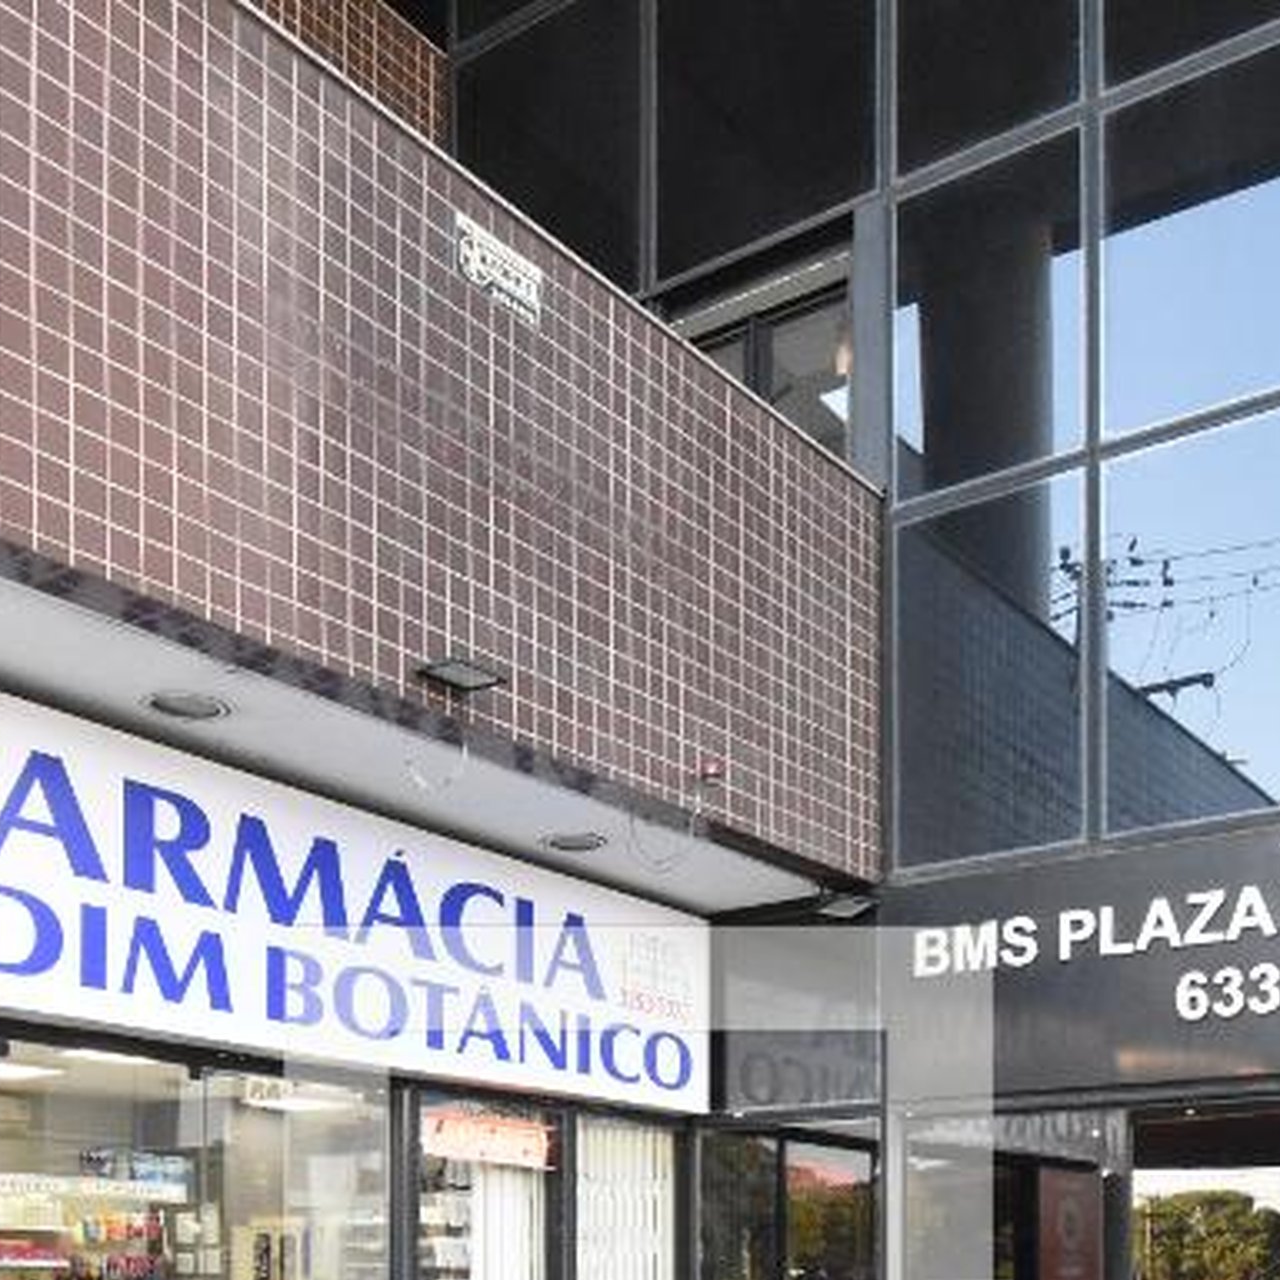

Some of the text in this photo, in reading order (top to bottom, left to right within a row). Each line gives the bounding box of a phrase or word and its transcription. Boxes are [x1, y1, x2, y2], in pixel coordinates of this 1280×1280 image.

[913, 885, 1278, 979] BMS PLAZA
[266, 944, 693, 1091] BOTÂNICO
